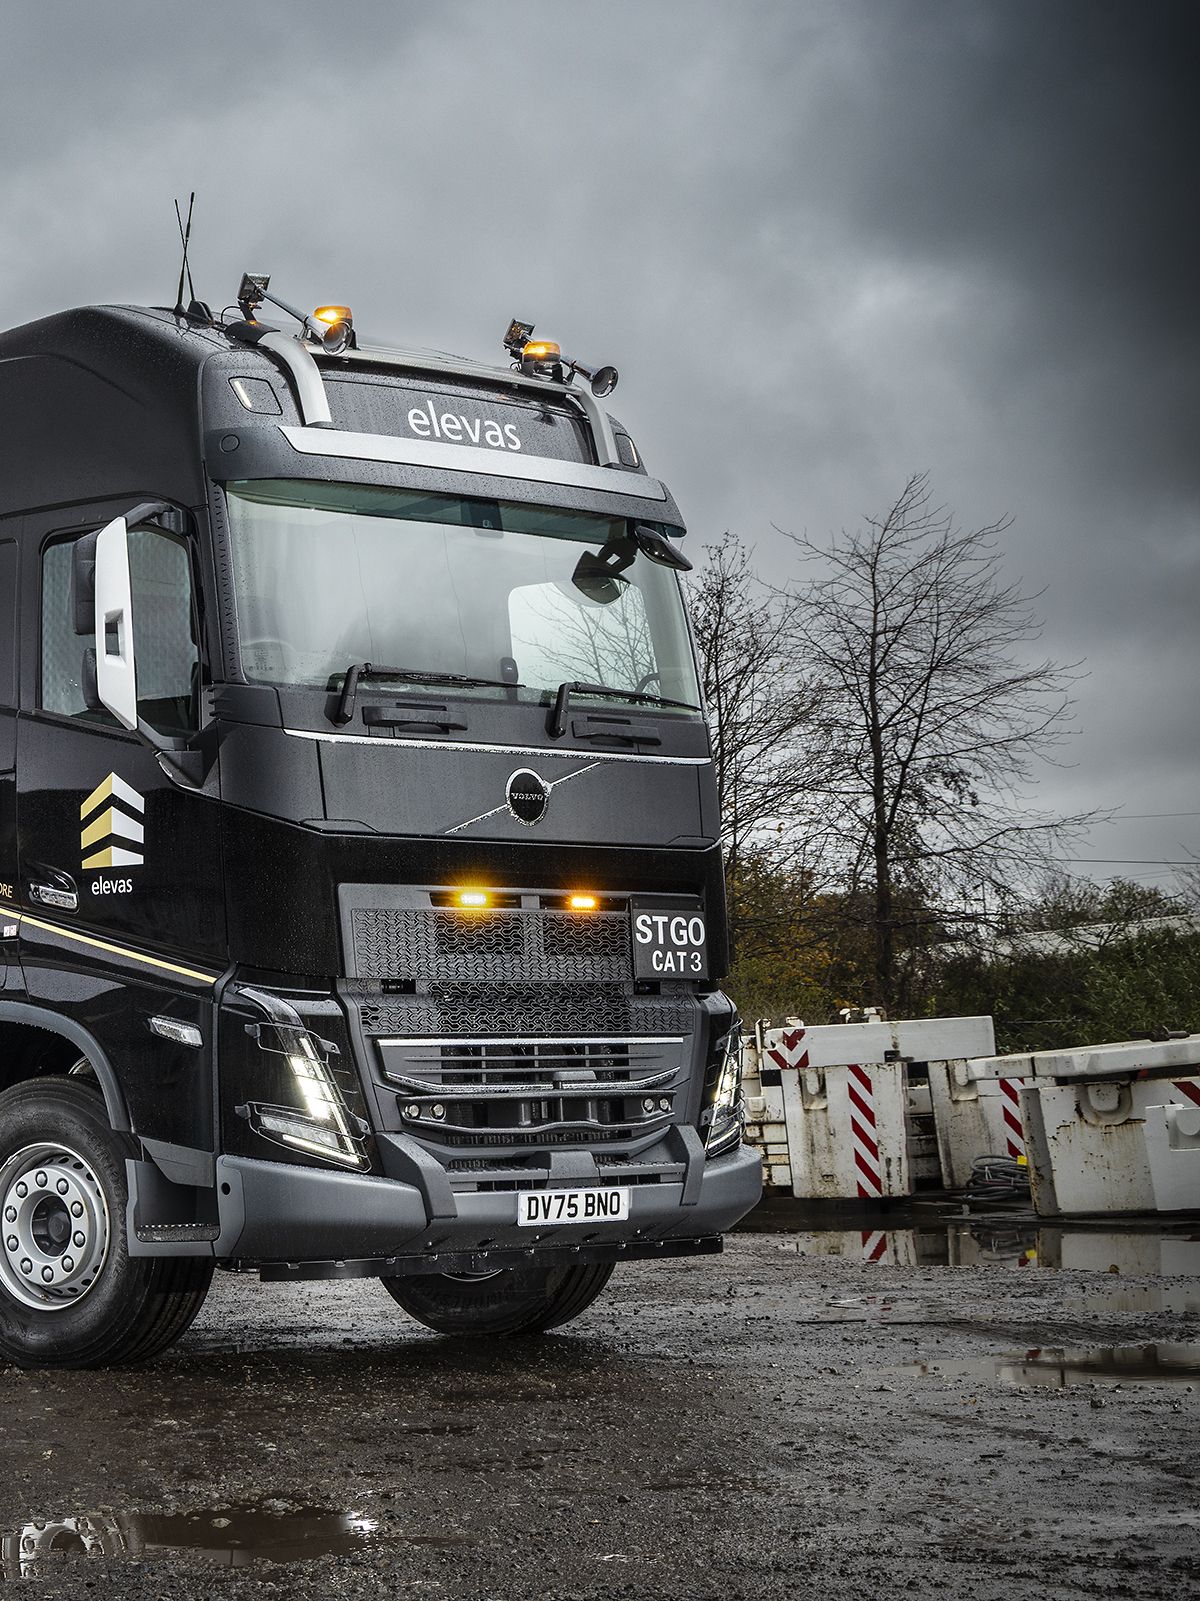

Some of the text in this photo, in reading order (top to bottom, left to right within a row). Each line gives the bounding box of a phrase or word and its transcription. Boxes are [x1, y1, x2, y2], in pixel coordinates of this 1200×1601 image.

[407, 400, 521, 450] elevas
[510, 792, 544, 801] VOLVO
[91, 875, 133, 895] elevas
[635, 914, 706, 946] STGO
[652, 949, 703, 972] CAT 3
[527, 1191, 621, 1221] DV75 BNO
